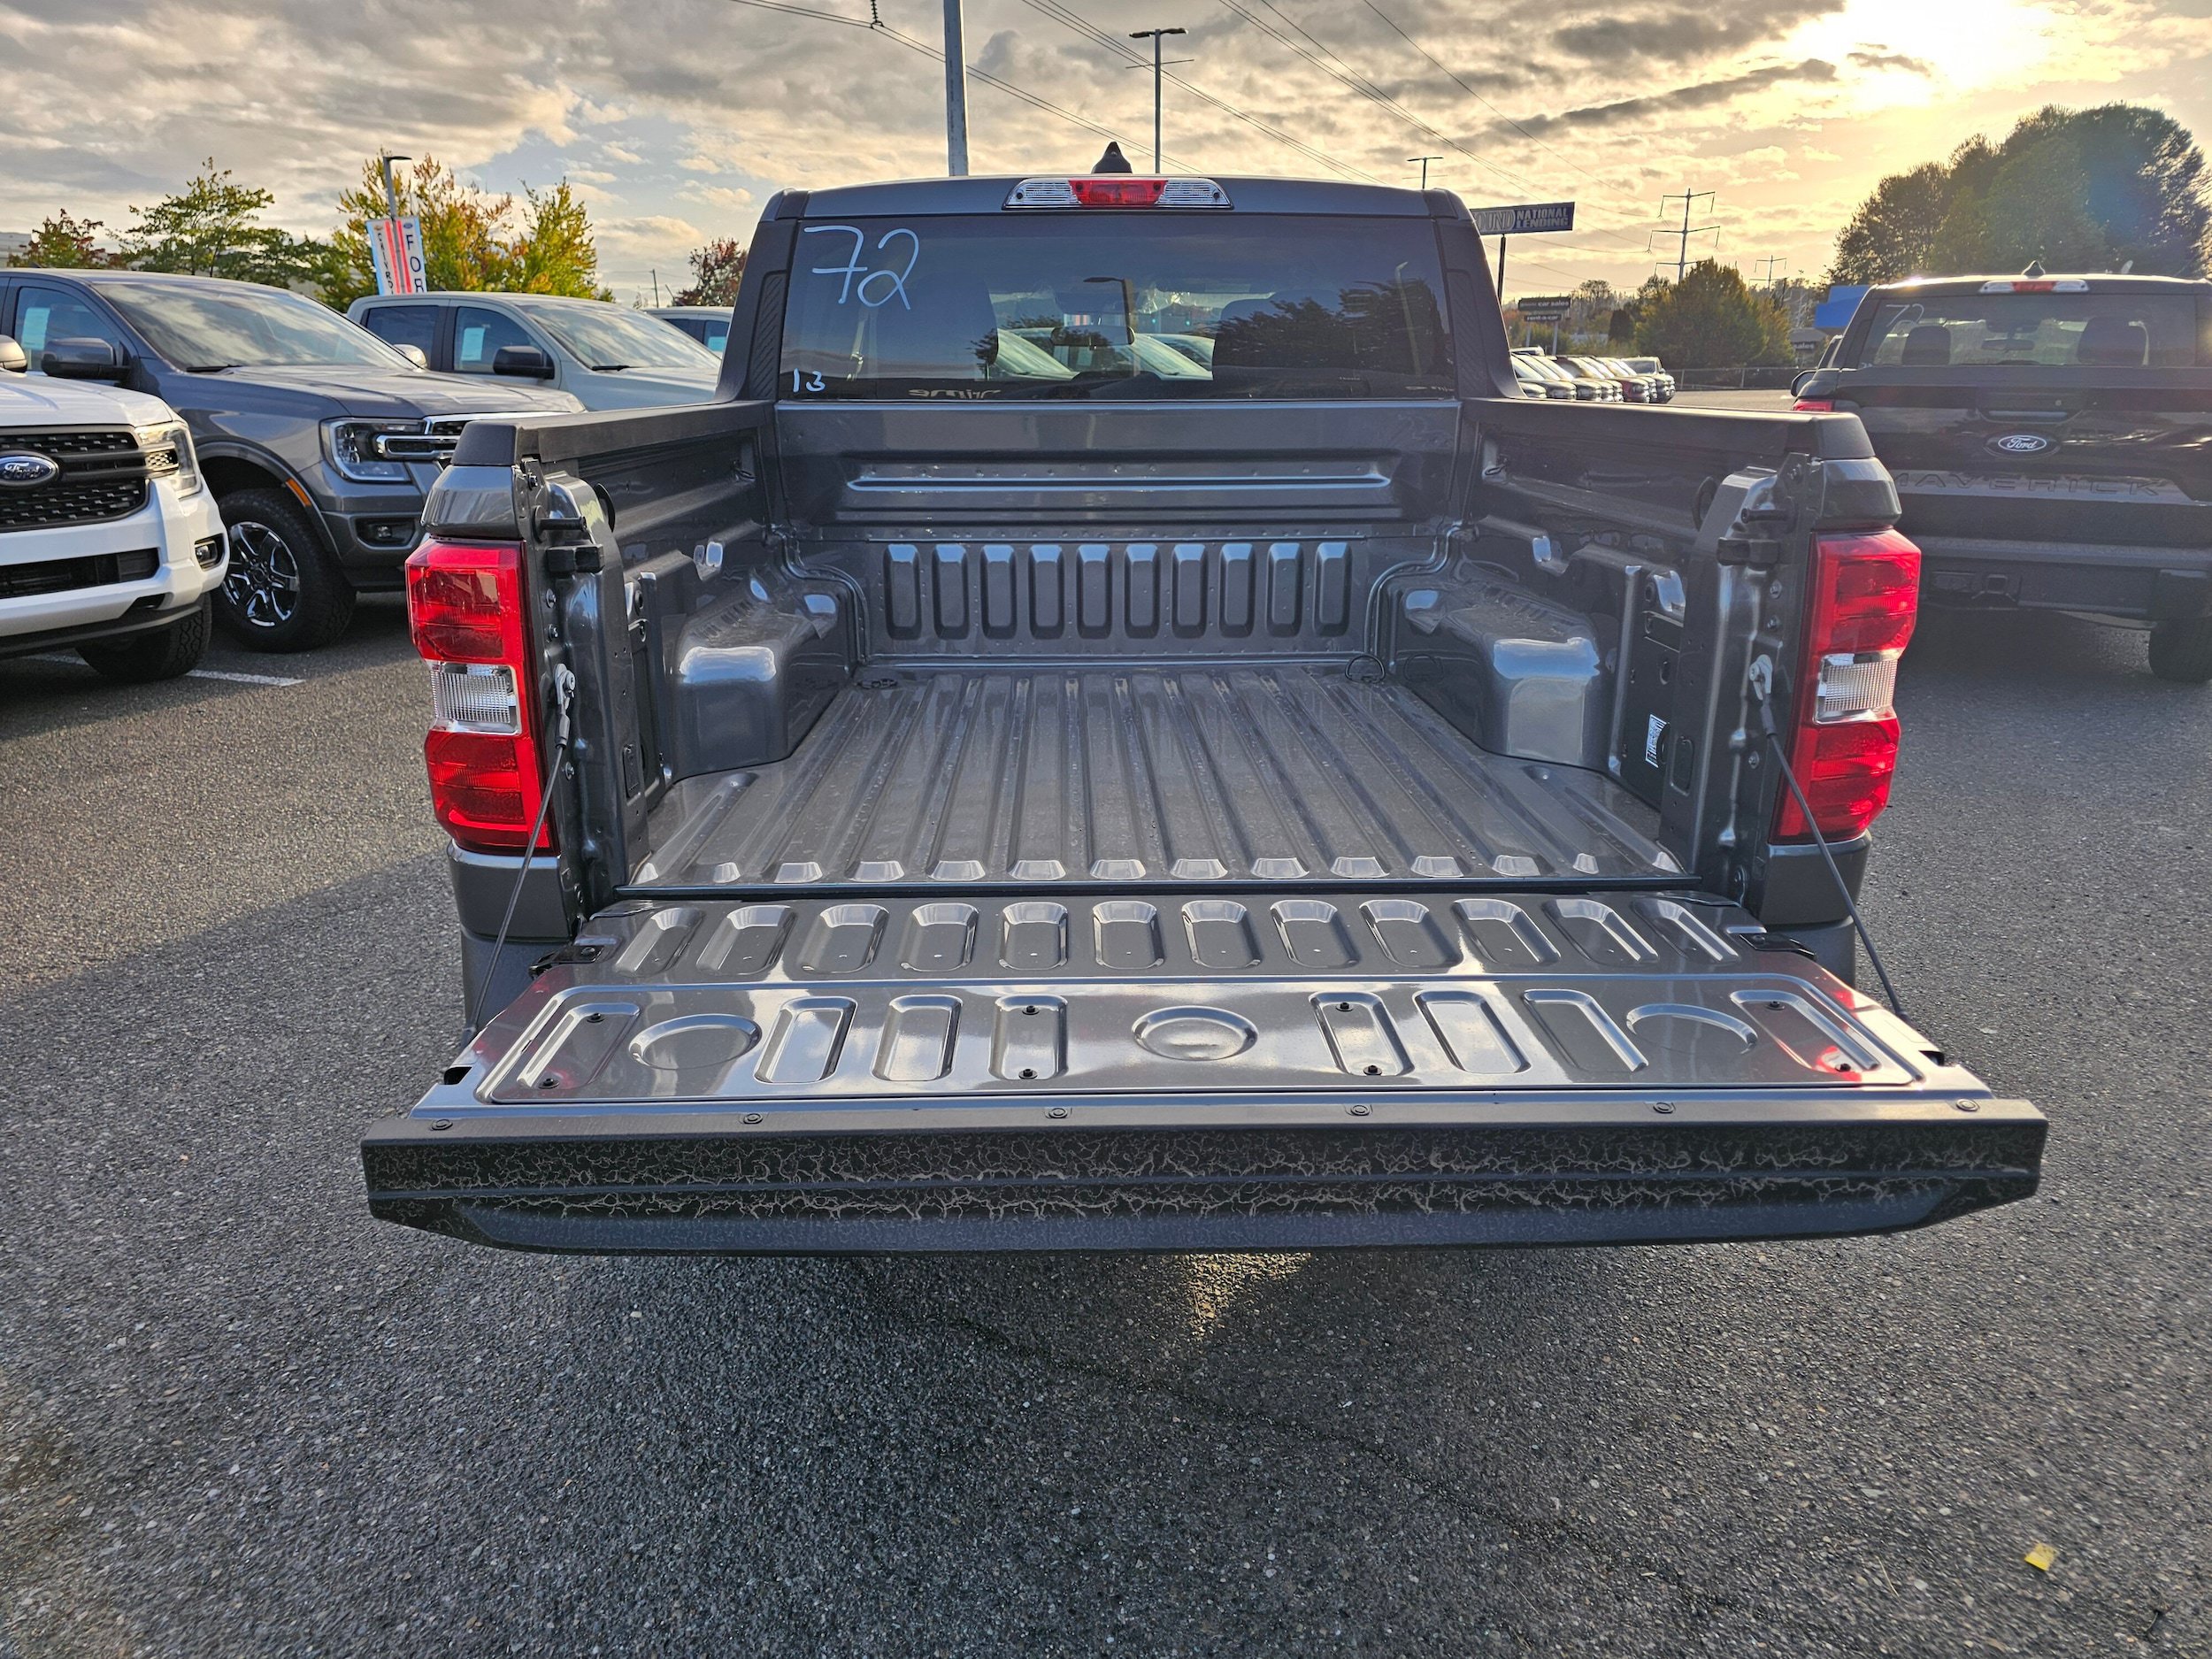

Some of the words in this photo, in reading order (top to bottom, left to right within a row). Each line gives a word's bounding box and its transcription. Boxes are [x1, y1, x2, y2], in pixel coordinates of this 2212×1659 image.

[1517, 207, 1568, 221] NATIONAL
[1516, 218, 1568, 228] LENDING
[804, 225, 919, 310] 72
